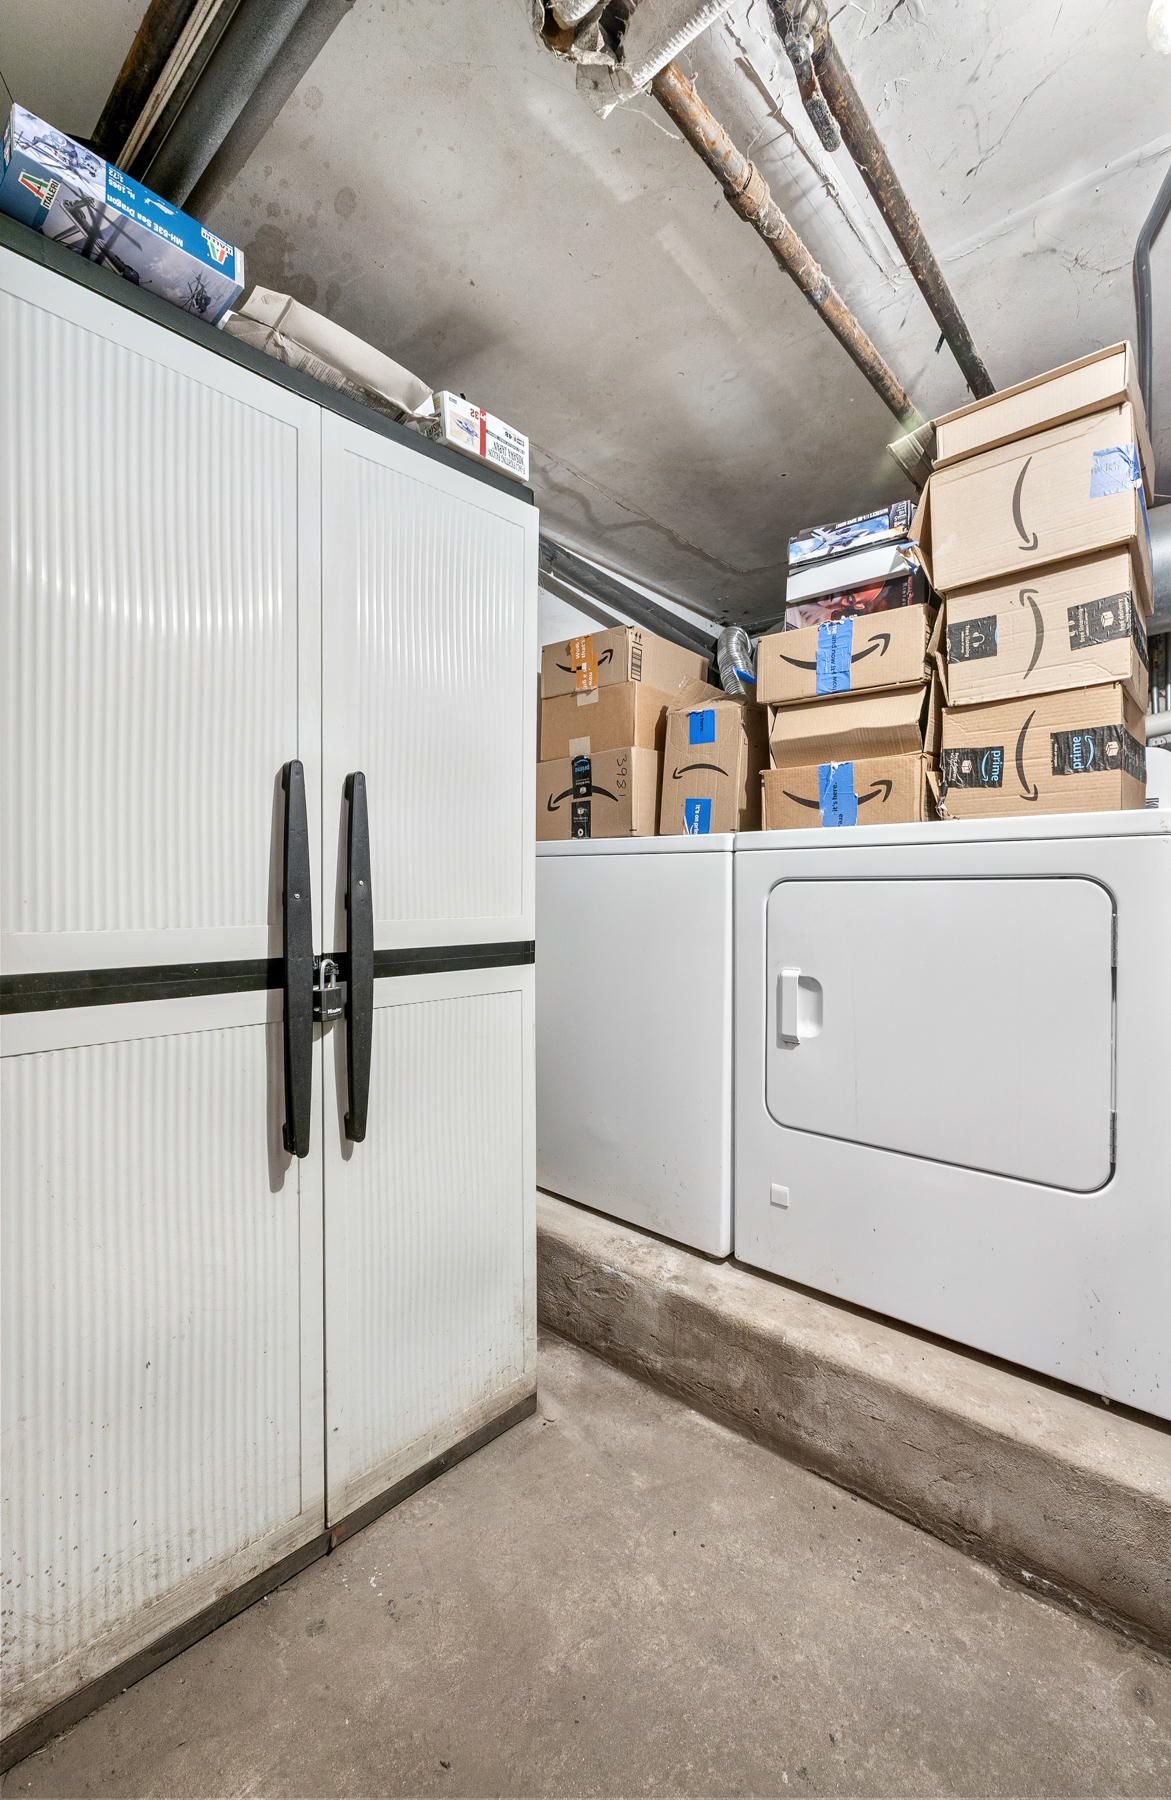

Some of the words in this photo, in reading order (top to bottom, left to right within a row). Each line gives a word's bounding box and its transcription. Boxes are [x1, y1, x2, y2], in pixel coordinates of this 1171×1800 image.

[108, 169, 124, 182] 1:72
[108, 178, 126, 194] 1065
[42, 180, 60, 209] ITALERI
[107, 194, 136, 218] Dragon
[137, 212, 152, 228] Sea
[153, 222, 184, 247] MH-53E
[1070, 736, 1085, 769] prime
[574, 764, 590, 773] prime
[616, 754, 628, 796] 3981
[991, 750, 1003, 781] prime
